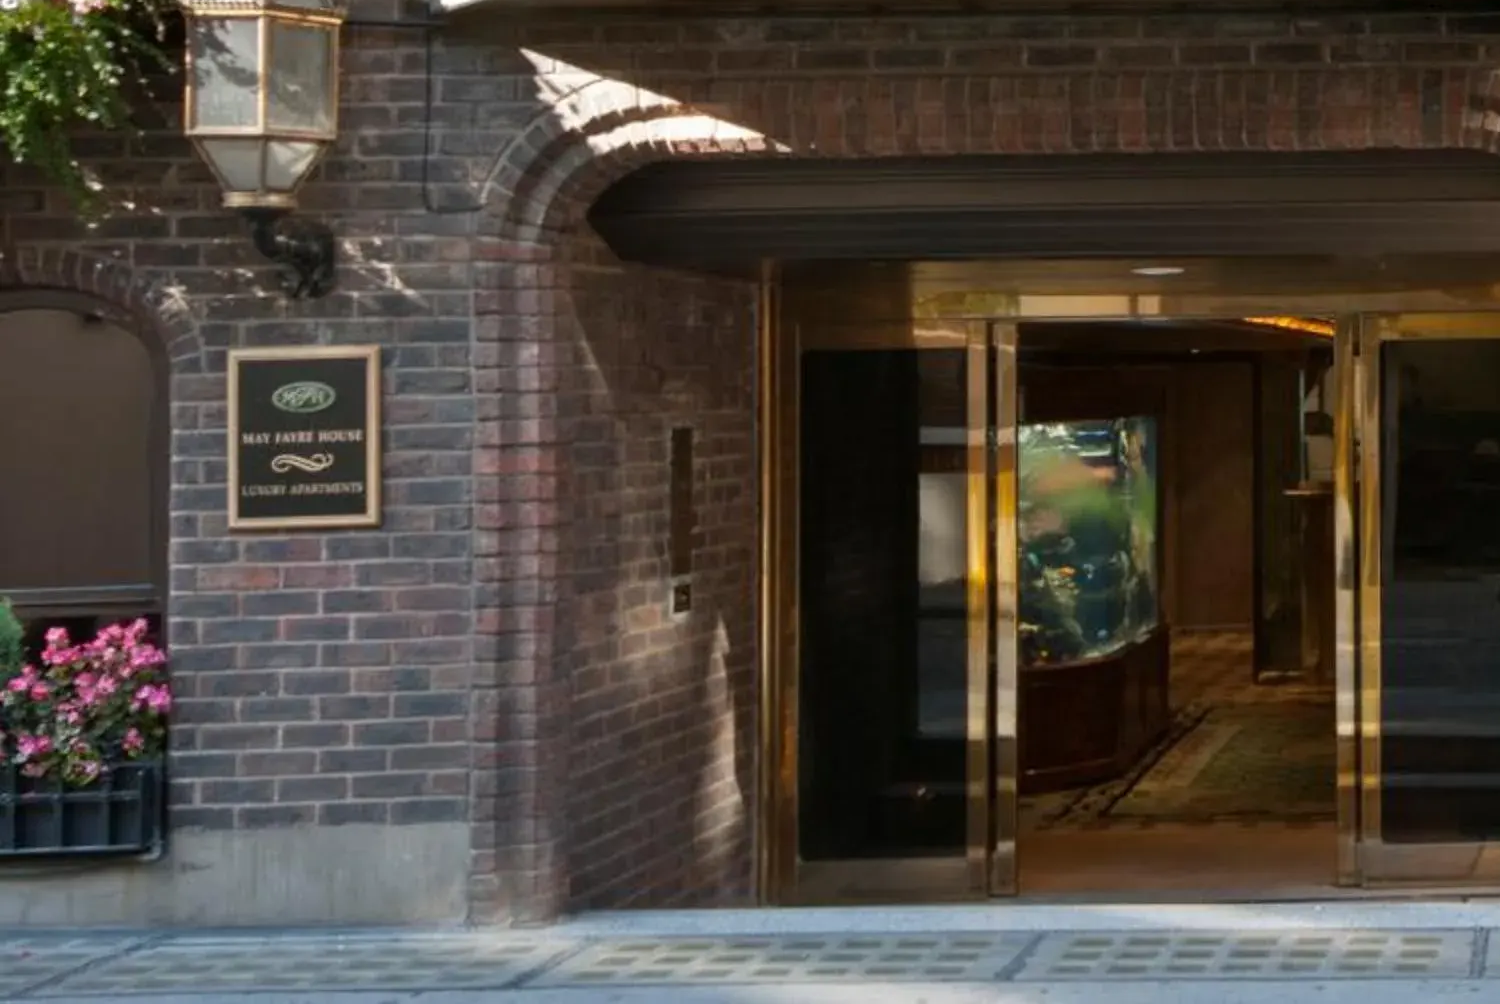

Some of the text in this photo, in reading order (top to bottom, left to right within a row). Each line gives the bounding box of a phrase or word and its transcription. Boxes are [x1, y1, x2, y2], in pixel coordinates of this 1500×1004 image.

[242, 429, 363, 445] MAY FAYRE HOUSE
[241, 481, 364, 497] LUXURY APARTMENTS
